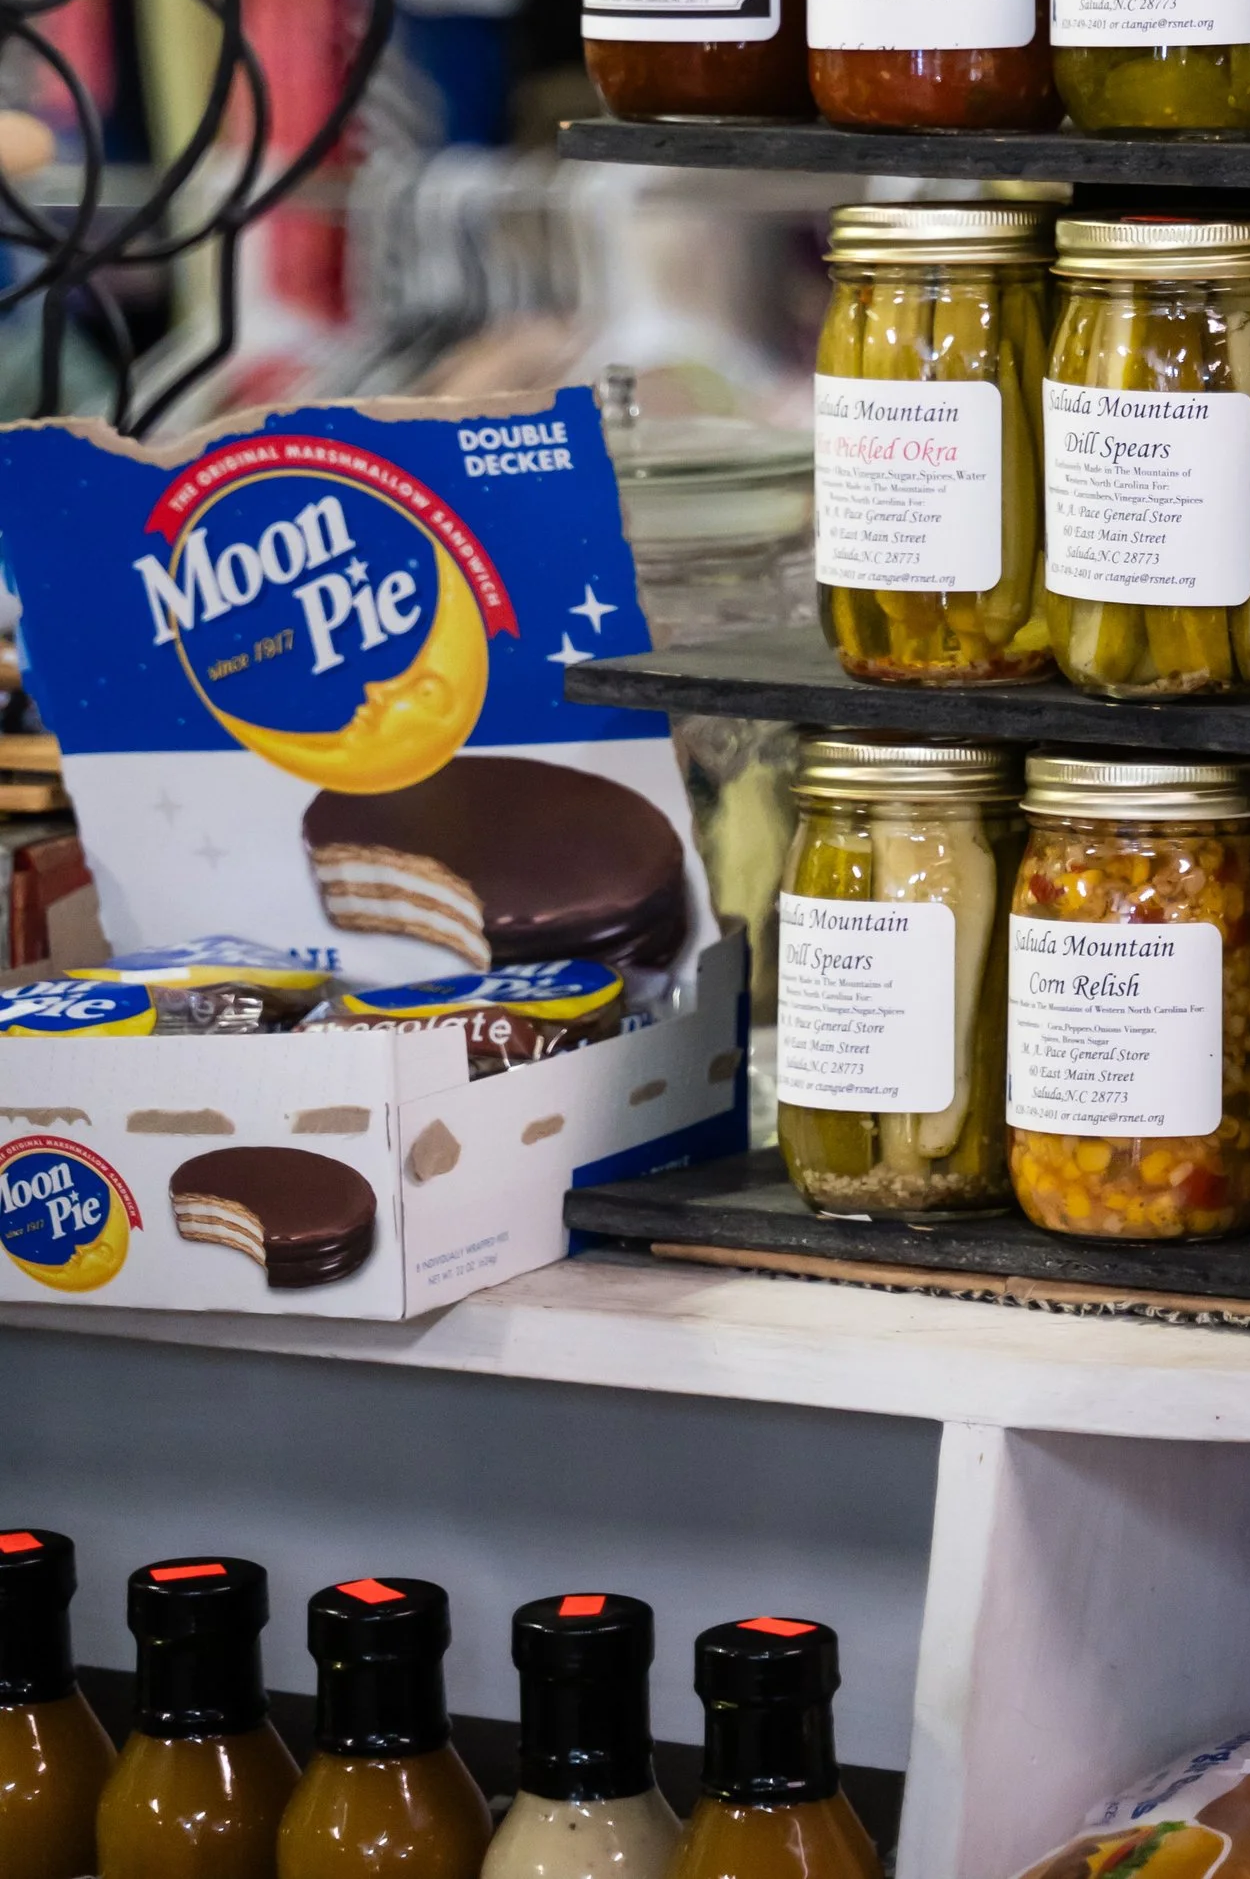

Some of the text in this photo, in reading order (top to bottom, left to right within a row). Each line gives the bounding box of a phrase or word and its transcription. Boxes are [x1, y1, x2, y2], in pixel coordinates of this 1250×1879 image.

[854, 399, 960, 423] Mountain
[1049, 389, 1209, 420] Saluda Mountain
[458, 421, 568, 451] DOUBLE
[1064, 432, 1171, 464] Dill Spears
[464, 448, 575, 478] DECKER
[835, 436, 900, 465] Pickled
[903, 438, 958, 467] Okra
[1134, 467, 1179, 477] Mountains
[1114, 479, 1149, 490] Carolina
[166, 443, 502, 608] THE ORIGINAL MARSHMALLOW SANDWICH
[866, 509, 942, 524] General Store
[1079, 505, 1182, 524] Pace General Store
[861, 530, 926, 544] Main Street
[1075, 526, 1166, 544] East Main Street
[885, 552, 920, 564] 28773
[1124, 552, 1159, 564] 28773
[132, 495, 357, 647] Moon
[292, 563, 422, 677] Pie
[208, 628, 296, 683] since 1917
[809, 908, 909, 932] Mountain
[1015, 929, 1175, 957] Saluda Mountain
[811, 947, 873, 975] Spears
[1029, 972, 1140, 1000] Corn Relish
[1154, 1005, 1188, 1014] Carolina
[814, 1019, 884, 1034] General Store
[809, 1039, 870, 1055] Main Street
[1045, 1046, 1150, 1063] Pace General Store
[831, 1061, 864, 1075] 28773
[1040, 1066, 1135, 1083] East Main Street
[1091, 1091, 1128, 1104] 28773
[7, 1140, 136, 1217] ORIGINAL MARSHMALLOW SANDWICH
[45, 1192, 101, 1240] Pie
